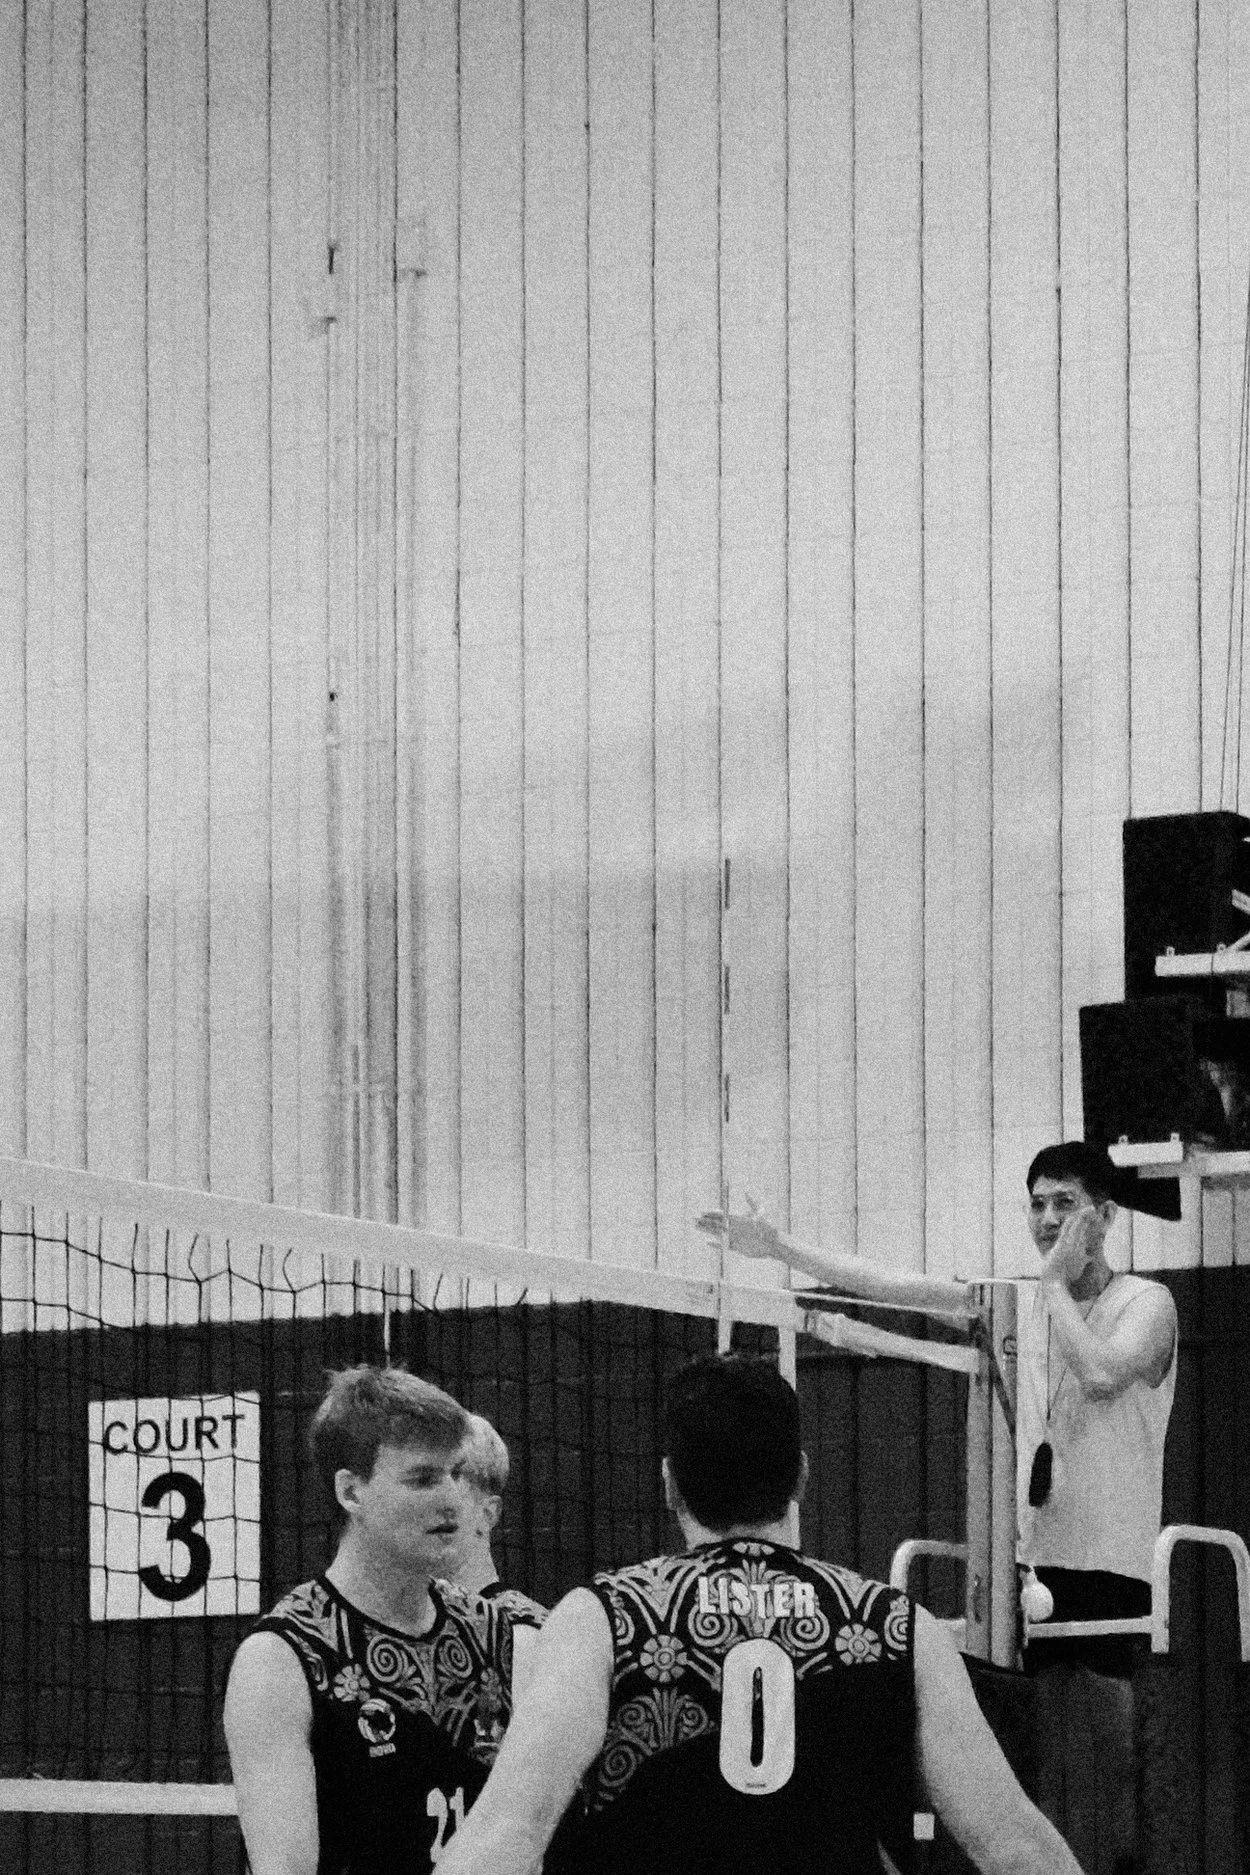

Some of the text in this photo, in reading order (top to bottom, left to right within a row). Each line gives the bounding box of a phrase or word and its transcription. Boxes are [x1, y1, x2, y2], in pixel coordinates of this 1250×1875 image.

[103, 1414, 245, 1455] COURT
[139, 1472, 211, 1602] 3
[698, 1576, 816, 1619] LISTER
[720, 1638, 795, 1795] 0
